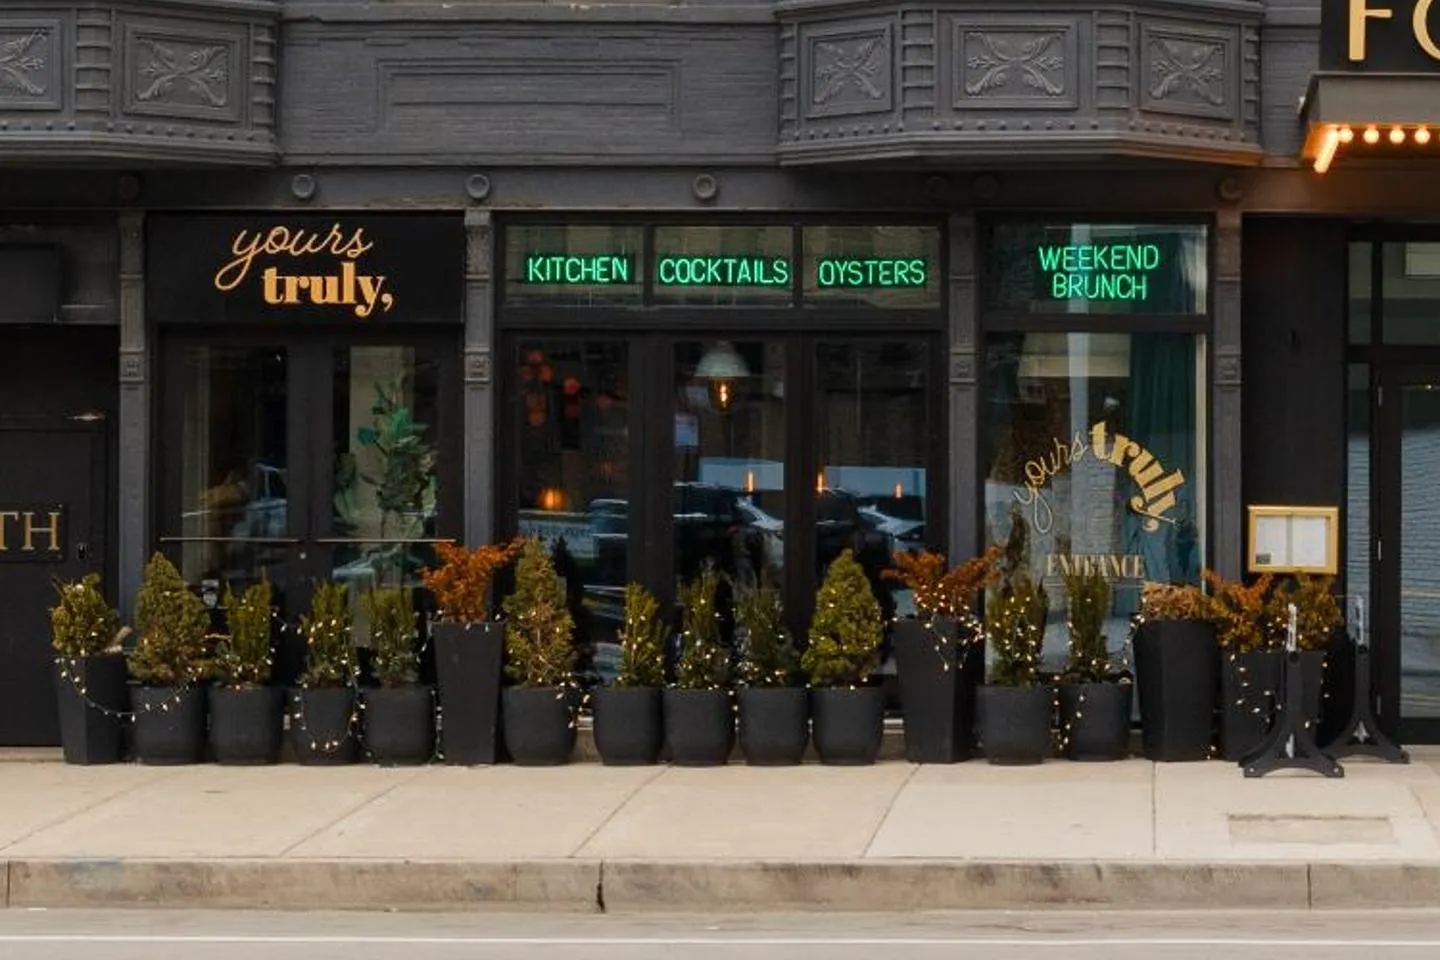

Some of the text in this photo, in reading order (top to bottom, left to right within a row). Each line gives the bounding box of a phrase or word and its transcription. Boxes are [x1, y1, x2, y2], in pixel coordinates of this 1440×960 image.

[214, 222, 374, 291] yours
[527, 256, 629, 283] KITCHEN
[1038, 244, 1159, 271] WEEKEND
[658, 257, 789, 285] COCKTAILS
[817, 259, 926, 286] OYSTERS
[261, 261, 394, 317] truly,
[1052, 272, 1147, 300] BRUNCH
[1013, 420, 1185, 534] yours truly,
[1046, 553, 1144, 578] ENTRANCE
